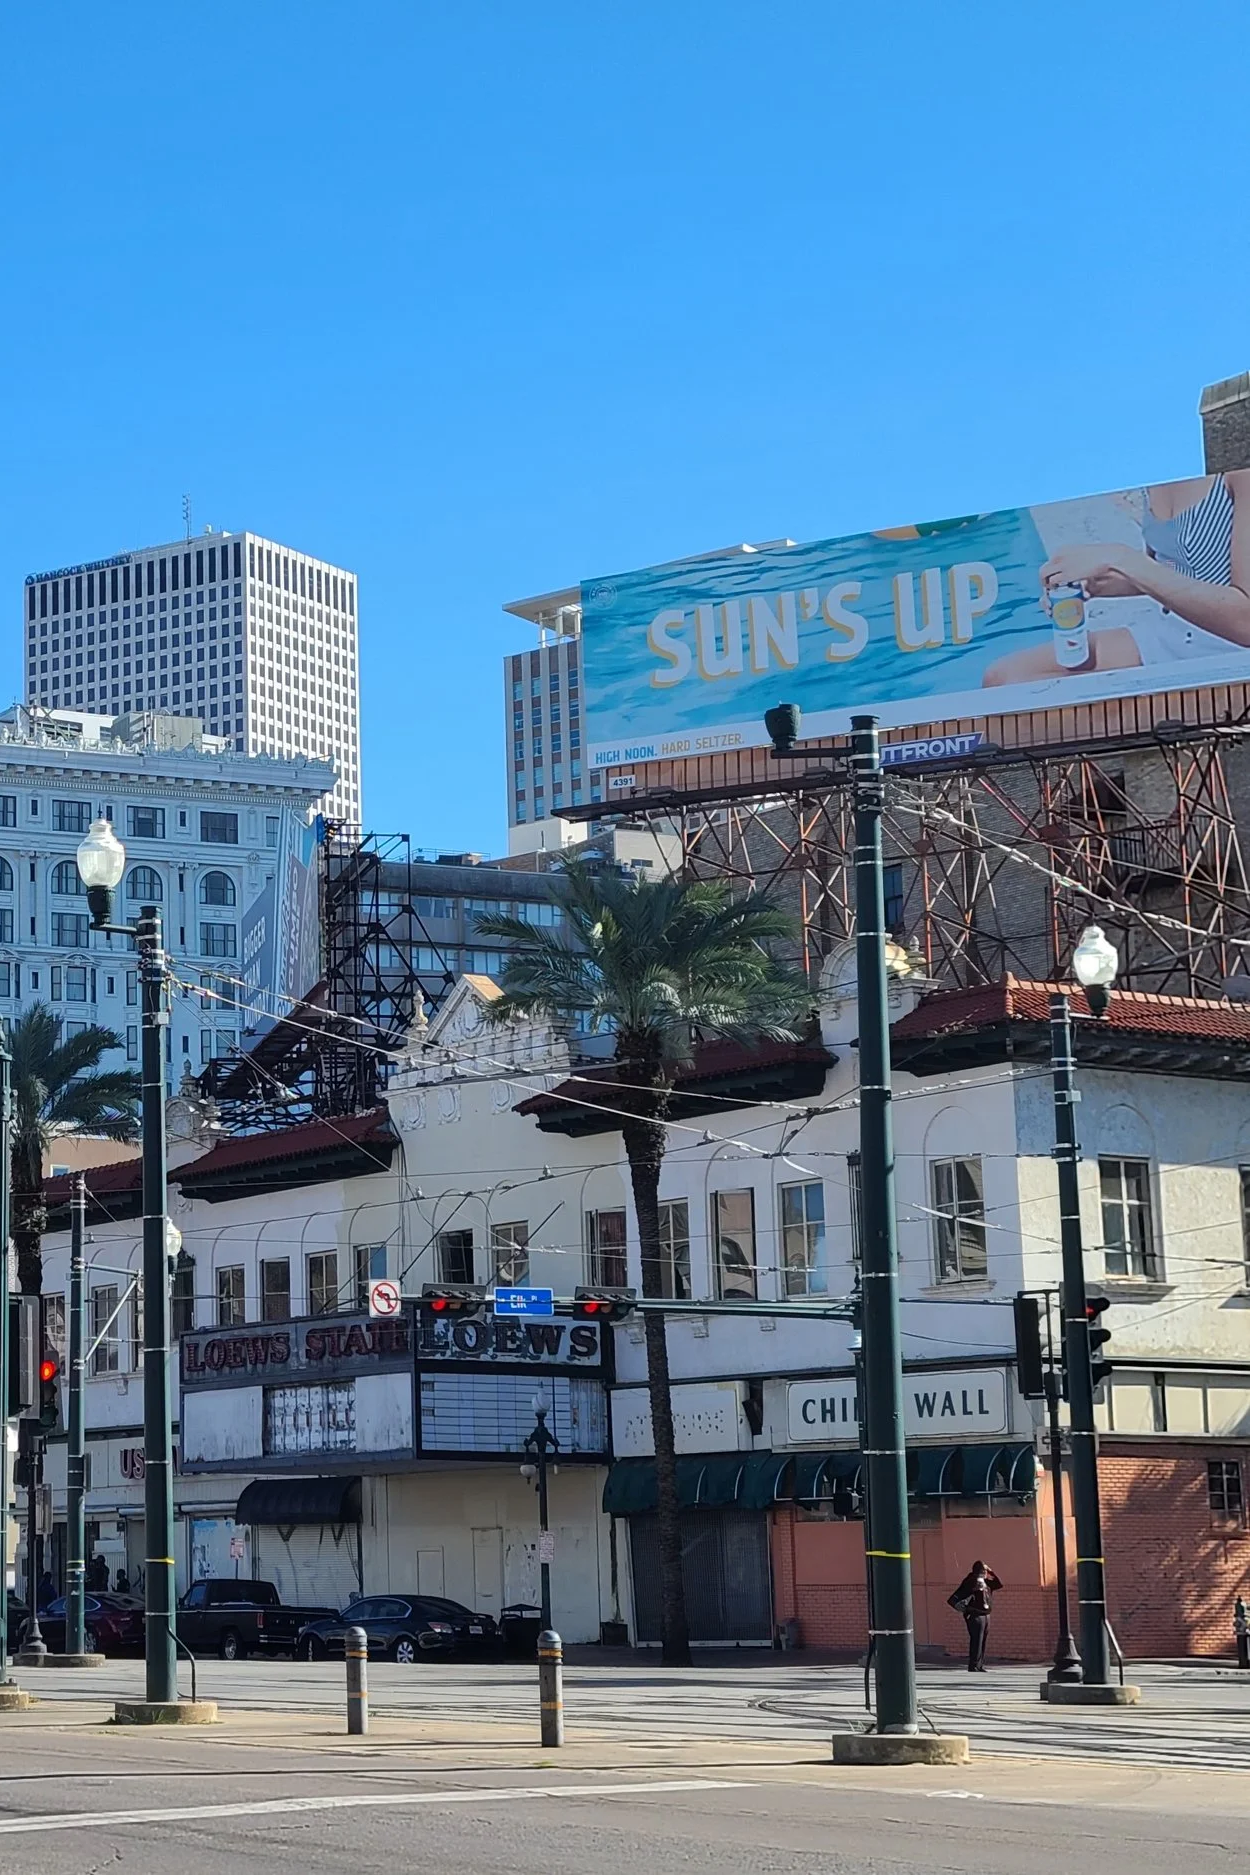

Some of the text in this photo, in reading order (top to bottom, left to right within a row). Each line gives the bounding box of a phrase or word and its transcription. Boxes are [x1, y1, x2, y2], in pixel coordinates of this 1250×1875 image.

[36, 554, 133, 583] HANCOCK WHITNEY
[647, 561, 999, 688] SUN'S UP
[595, 732, 745, 765] HIGH NOON. HARD SELTZER.
[880, 735, 976, 762] TFRONT
[612, 777, 633, 787] 4391
[244, 915, 266, 965] BIGGER
[244, 957, 261, 1000] THAN
[510, 1294, 527, 1309] Elk
[186, 1319, 408, 1372] LOEWS STATE
[420, 1318, 599, 1357] LOEWS
[802, 1389, 990, 1425] CHI WALL
